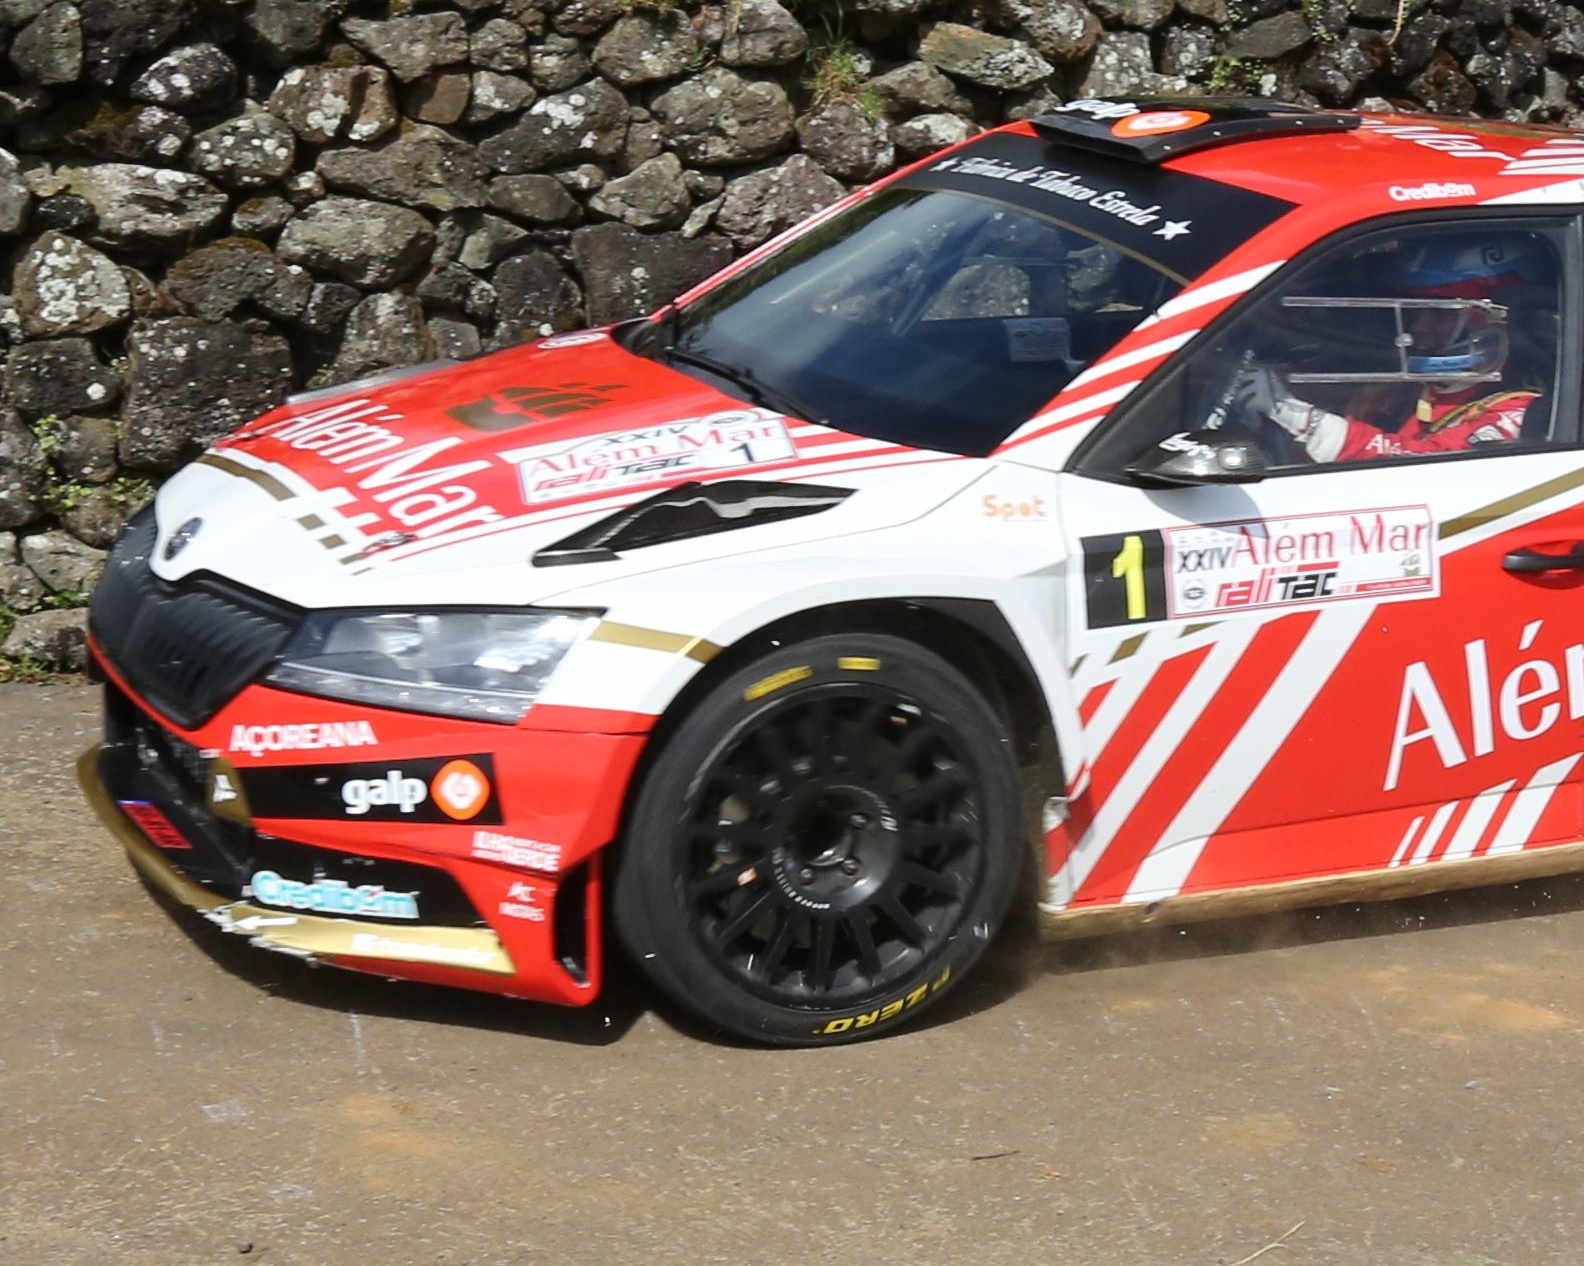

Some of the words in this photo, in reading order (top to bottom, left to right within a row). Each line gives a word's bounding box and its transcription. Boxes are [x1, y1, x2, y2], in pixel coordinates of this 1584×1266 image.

[1088, 190, 1162, 226] Estrela
[676, 424, 779, 451] Mar
[729, 442, 755, 464] 1
[1230, 524, 1335, 568] Além
[1350, 513, 1430, 555] Mar
[1112, 535, 1147, 620] 1
[229, 721, 379, 757] AÇOREANA
[342, 769, 428, 814] galp
